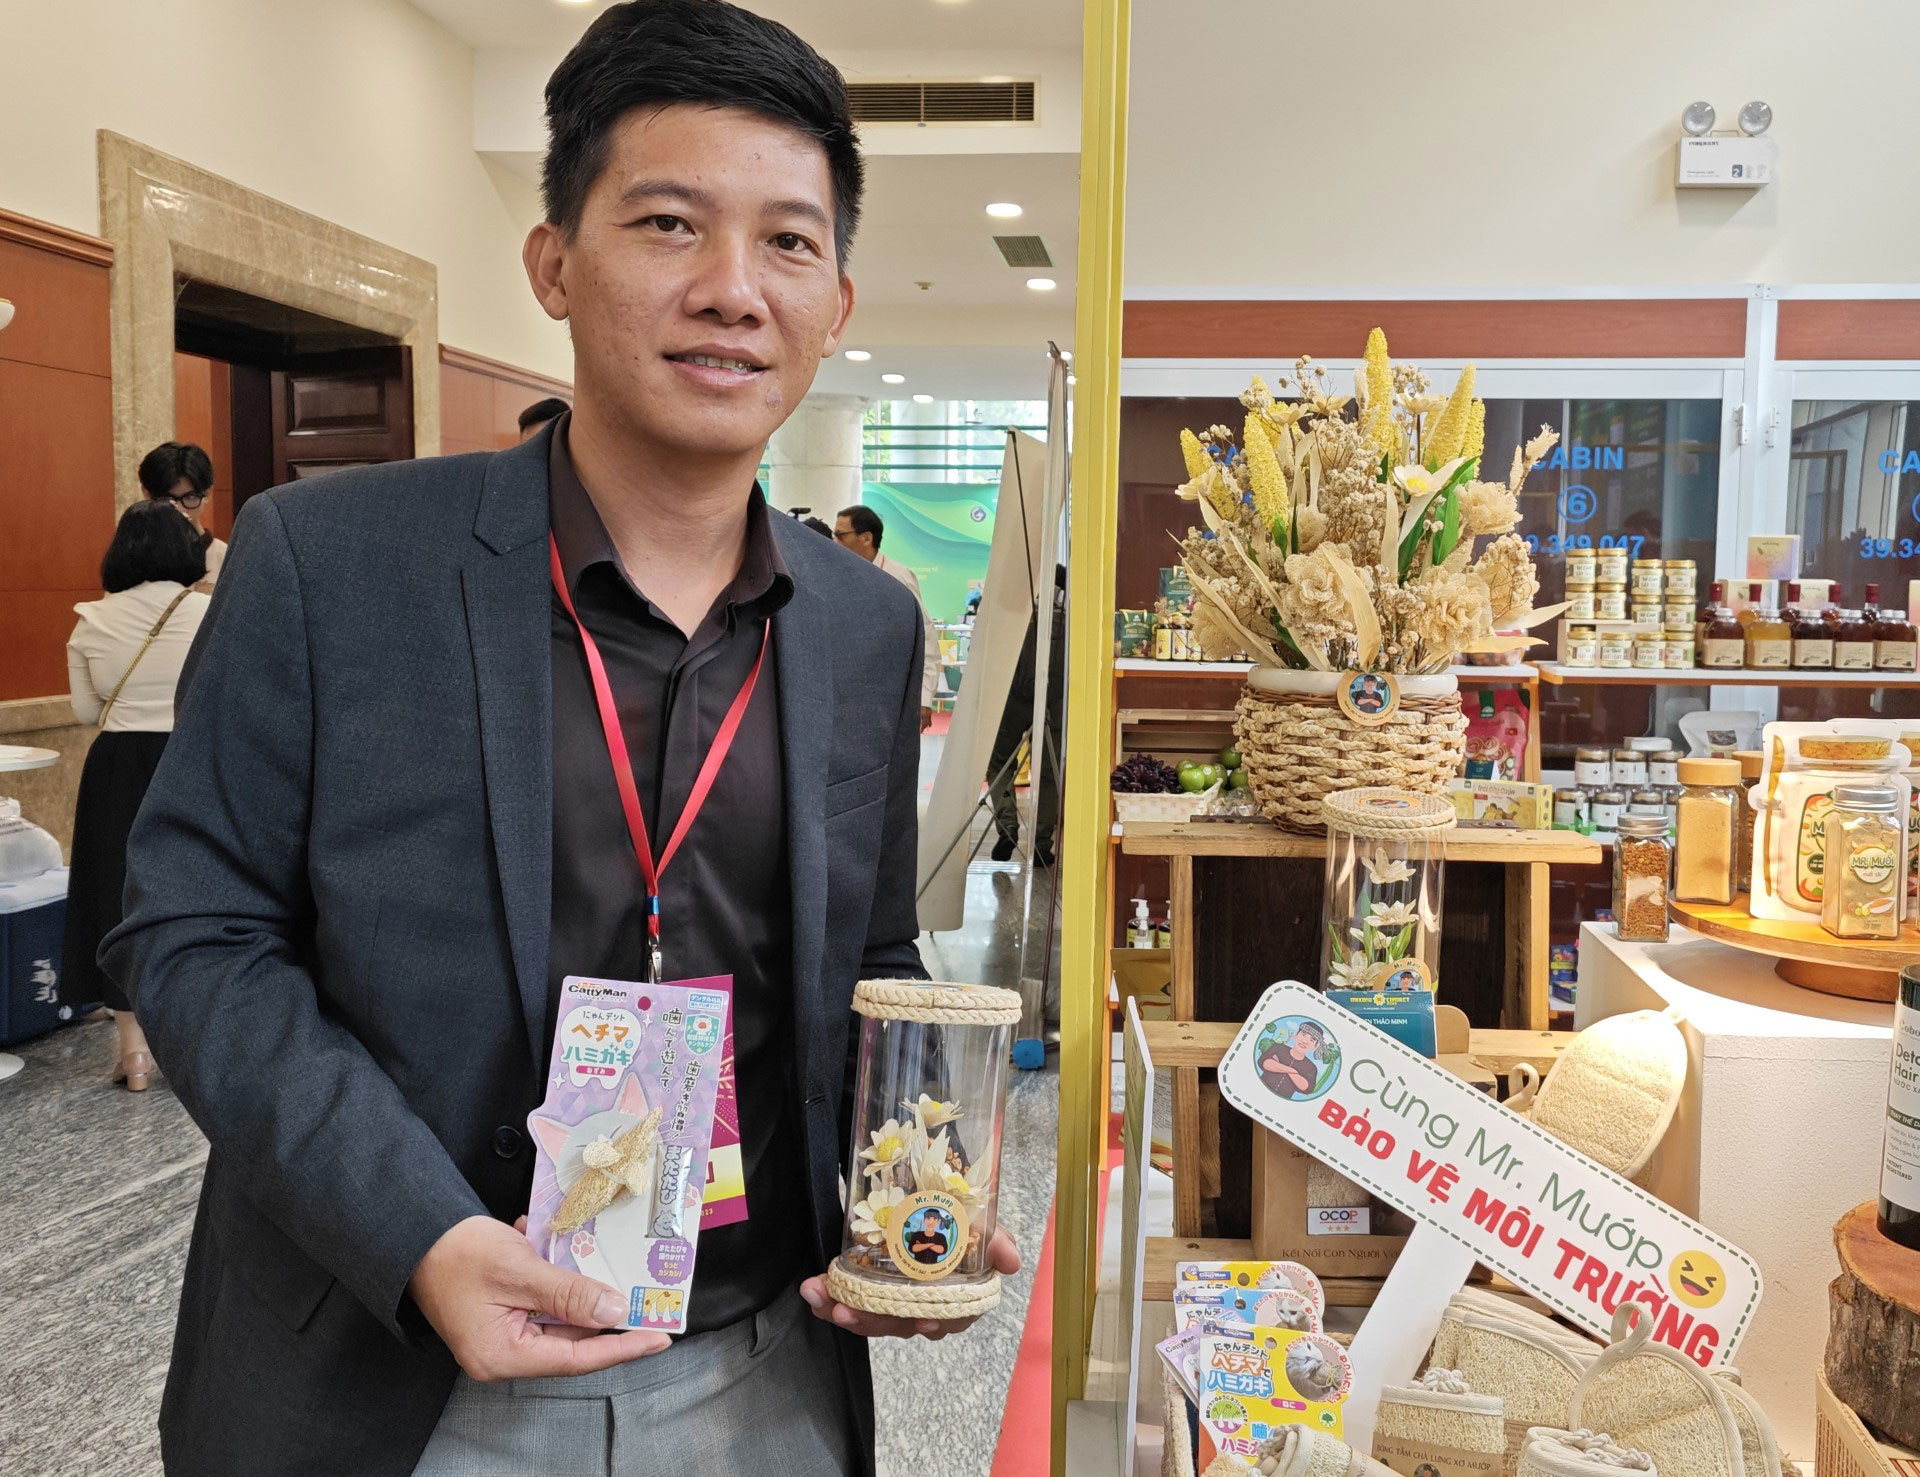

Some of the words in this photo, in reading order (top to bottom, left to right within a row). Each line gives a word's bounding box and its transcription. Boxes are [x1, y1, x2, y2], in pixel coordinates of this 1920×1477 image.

[1524, 533, 1646, 559] 9.349047
[1391, 1017, 1408, 1025] MINH
[1349, 1058, 1460, 1150] Cùng
[1464, 1126, 1524, 1190] Mr.
[1541, 1172, 1663, 1270] Mướp
[1319, 1210, 1358, 1221] OCOP
[1317, 1098, 1397, 1161] BẢO
[1406, 1148, 1460, 1205] VỆ
[1462, 1186, 1546, 1259] MÔI
[1552, 1236, 1721, 1369] TRƯỜNG
[1213, 1342, 1269, 1360] にゃんデント
[1206, 1369, 1274, 1399] ハミガキ
